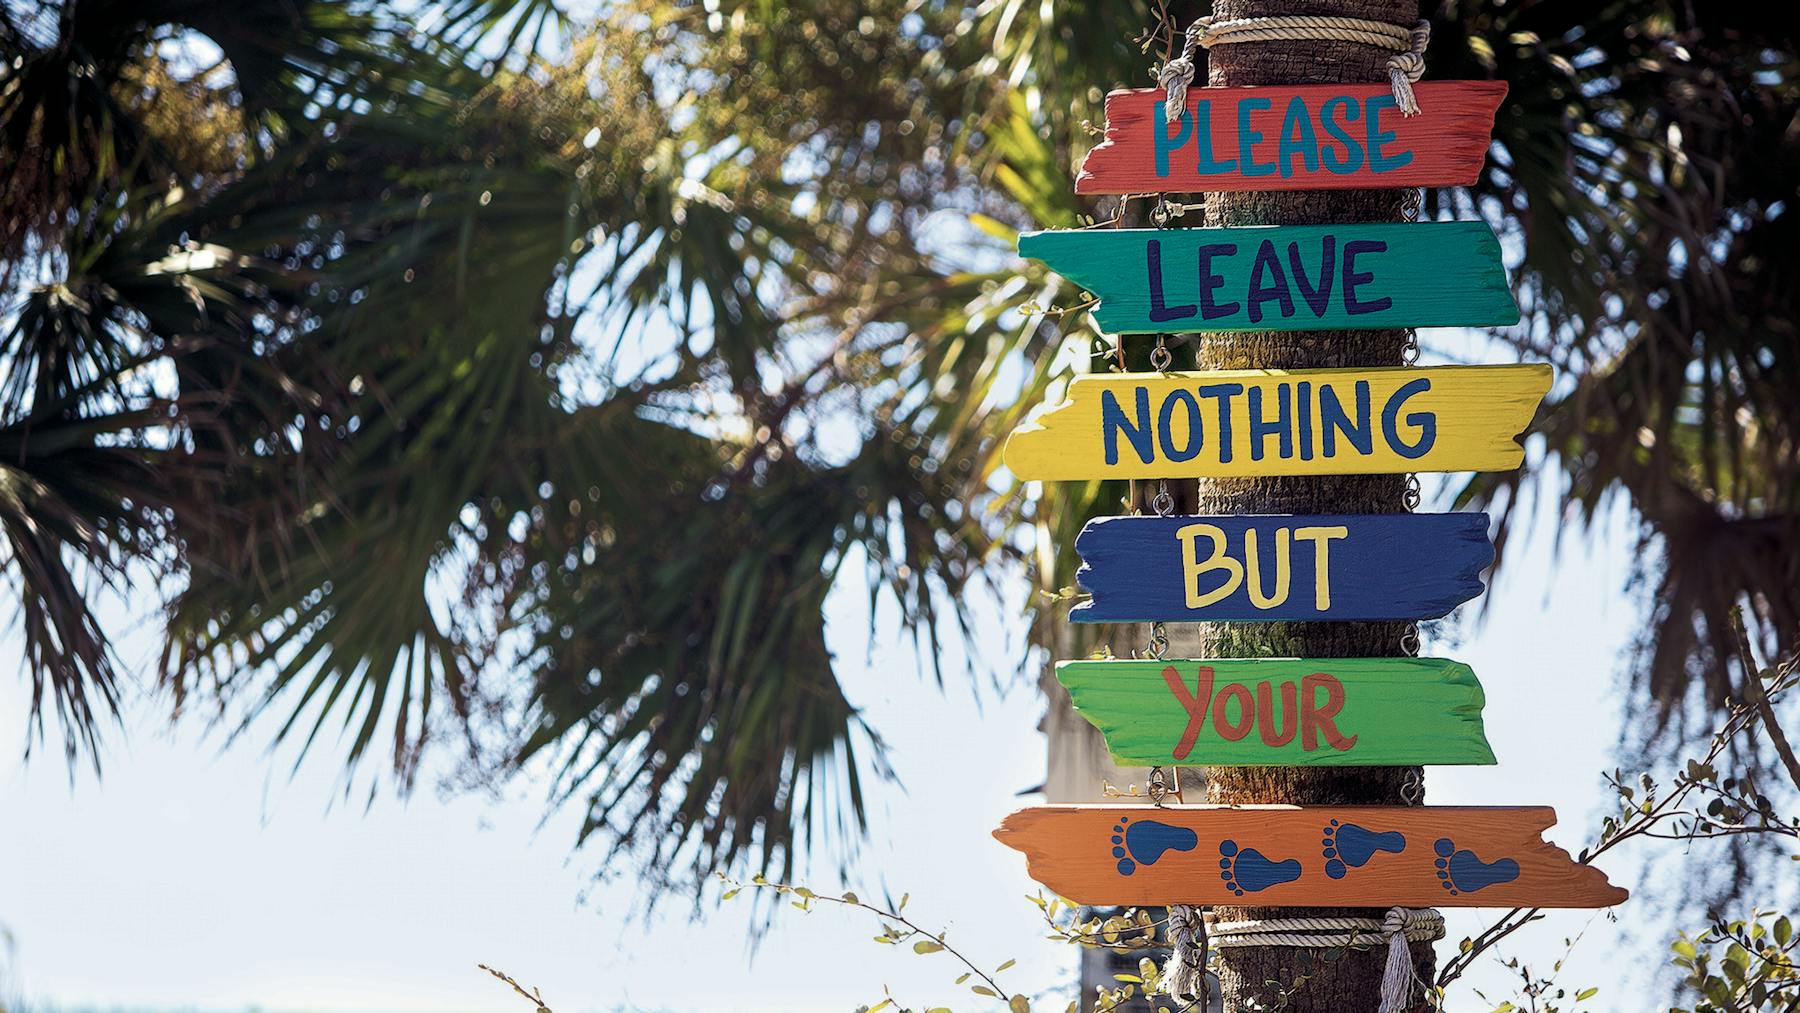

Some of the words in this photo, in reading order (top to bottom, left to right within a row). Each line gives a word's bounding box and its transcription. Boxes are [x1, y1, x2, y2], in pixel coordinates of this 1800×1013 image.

[1153, 95, 1413, 178] PLEASE
[1147, 235, 1393, 323] LEAVE
[1102, 378, 1437, 465] NOTHING
[1176, 524, 1348, 612] BUT
[1161, 665, 1358, 760] YOUR
